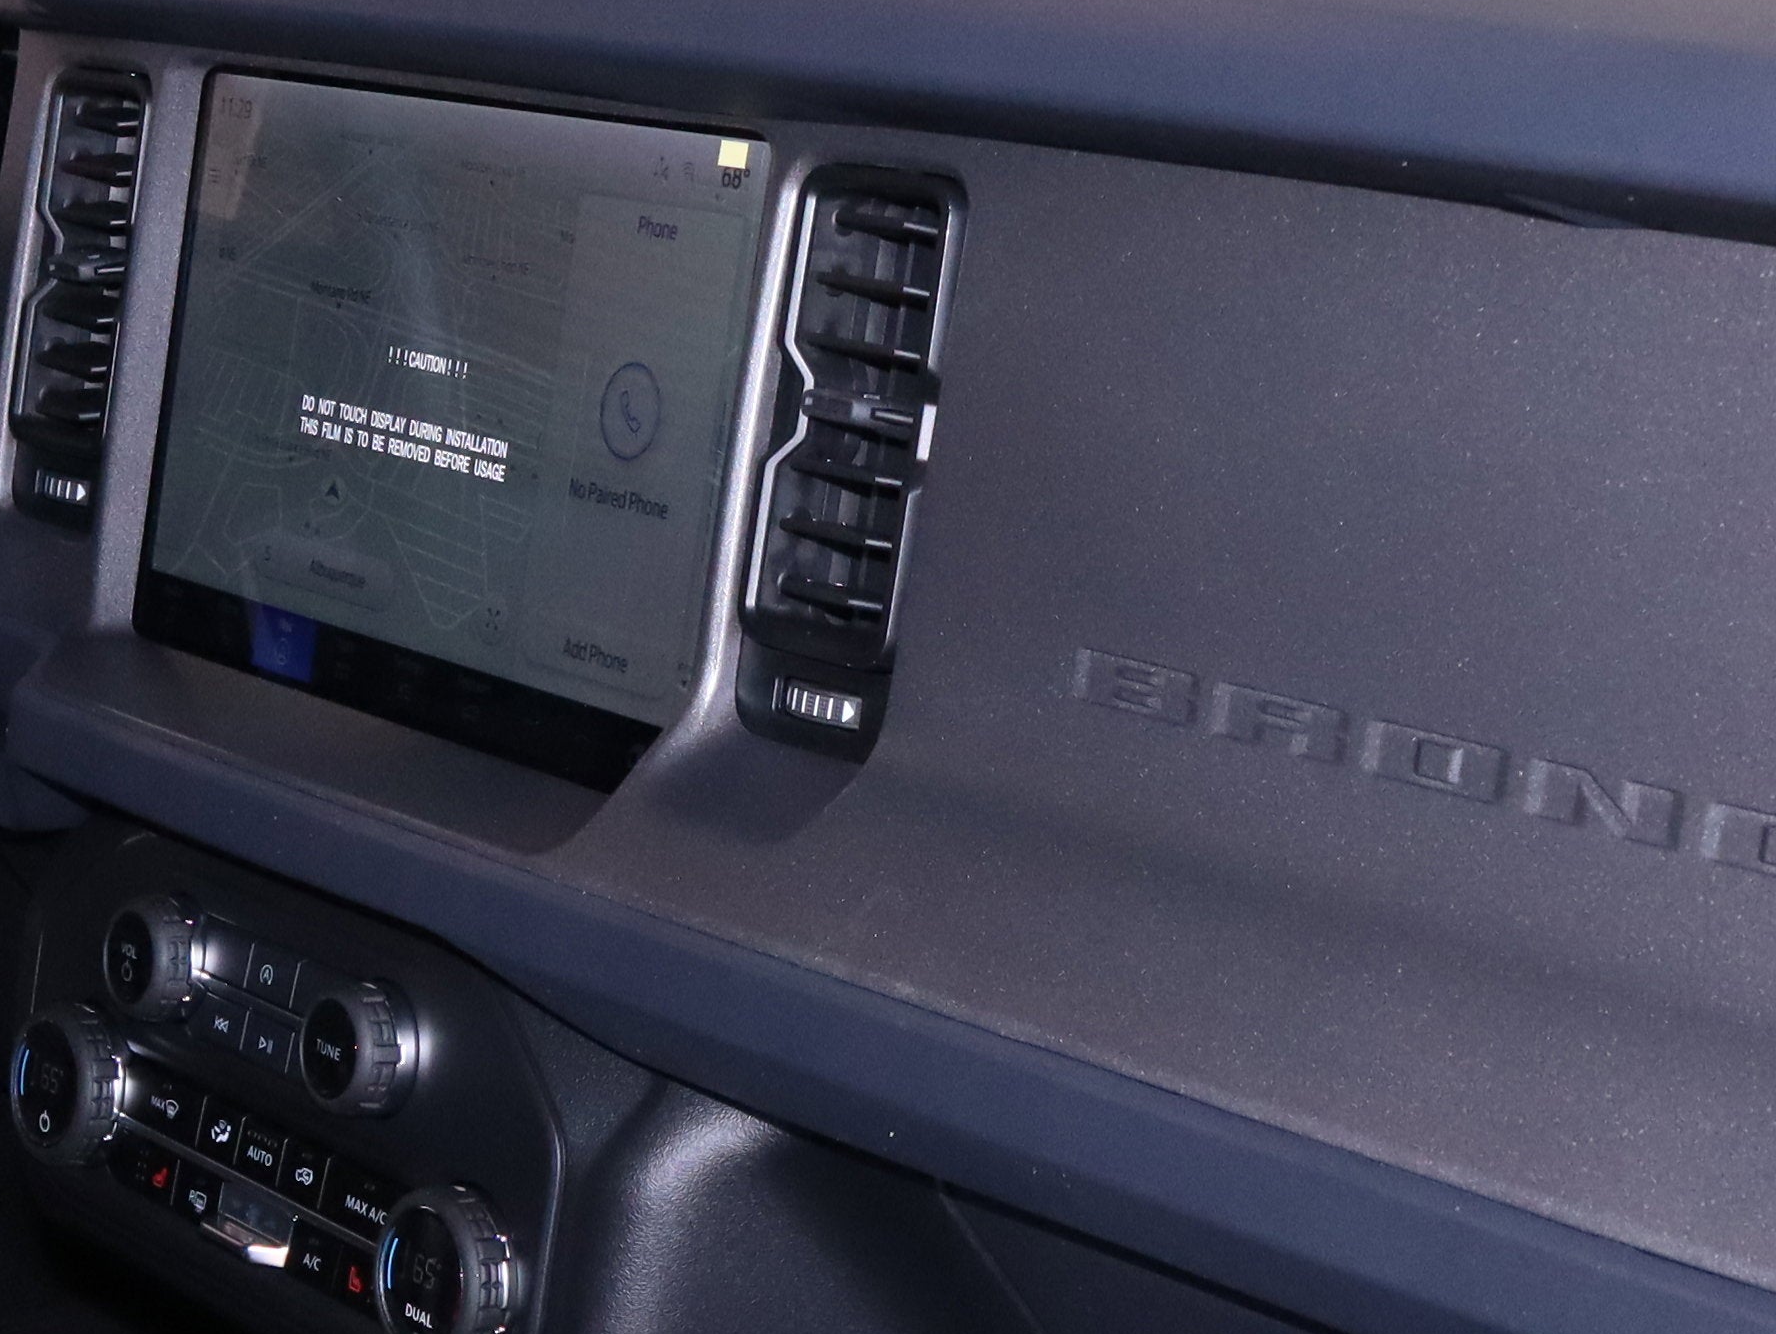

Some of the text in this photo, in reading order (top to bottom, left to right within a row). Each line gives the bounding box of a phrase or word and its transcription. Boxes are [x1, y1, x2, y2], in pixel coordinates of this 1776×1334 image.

[218, 96, 254, 122] 11:29
[636, 214, 679, 242] Phone
[301, 394, 509, 459] DO NOT TOUCH DISPLAY DURING INSTALLATION
[299, 416, 319, 436] THIS
[321, 422, 341, 443] FILM
[344, 427, 354, 445] IS
[357, 430, 369, 449] TO
[372, 434, 384, 453] BE
[387, 438, 431, 464] REMOVED
[434, 450, 470, 474] BEFORE
[473, 460, 507, 483] USAGE
[568, 476, 669, 521] No Paired Phone
[562, 636, 628, 675] Add Phone
[120, 941, 139, 961] VOL
[315, 1036, 342, 1064] TUNE
[150, 1094, 167, 1111] MAX
[246, 1144, 274, 1168] AUTO
[345, 1194, 390, 1227] MAX A/C
[302, 1253, 323, 1273] A/C
[404, 1302, 434, 1330] DUAL
